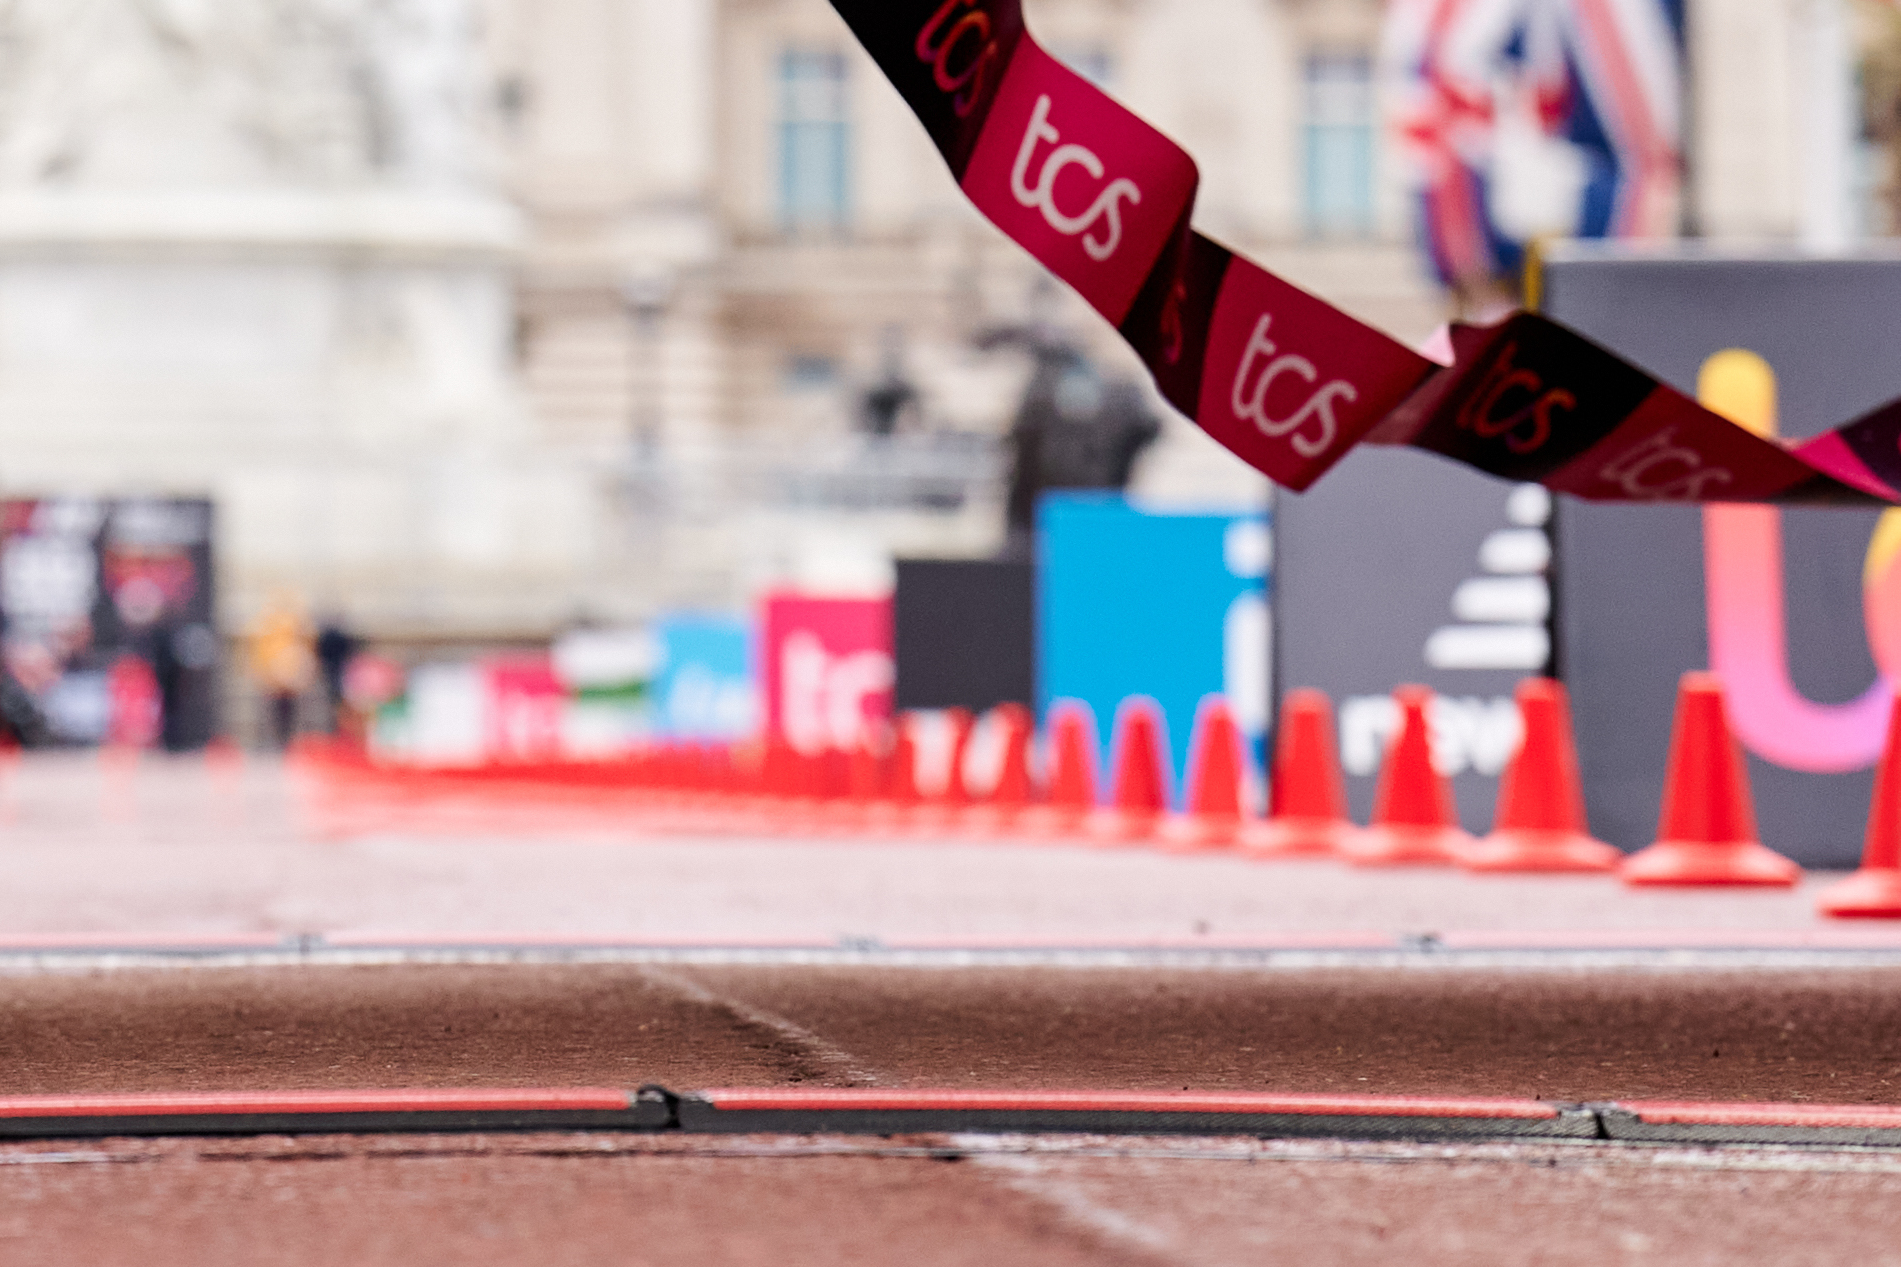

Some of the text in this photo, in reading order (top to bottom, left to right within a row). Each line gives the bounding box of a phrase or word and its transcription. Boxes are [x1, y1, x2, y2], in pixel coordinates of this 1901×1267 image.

[1010, 92, 1142, 262] tcs
[1230, 312, 1358, 458] tcs
[1456, 340, 1577, 455] tcs
[1338, 695, 1529, 777] nw
